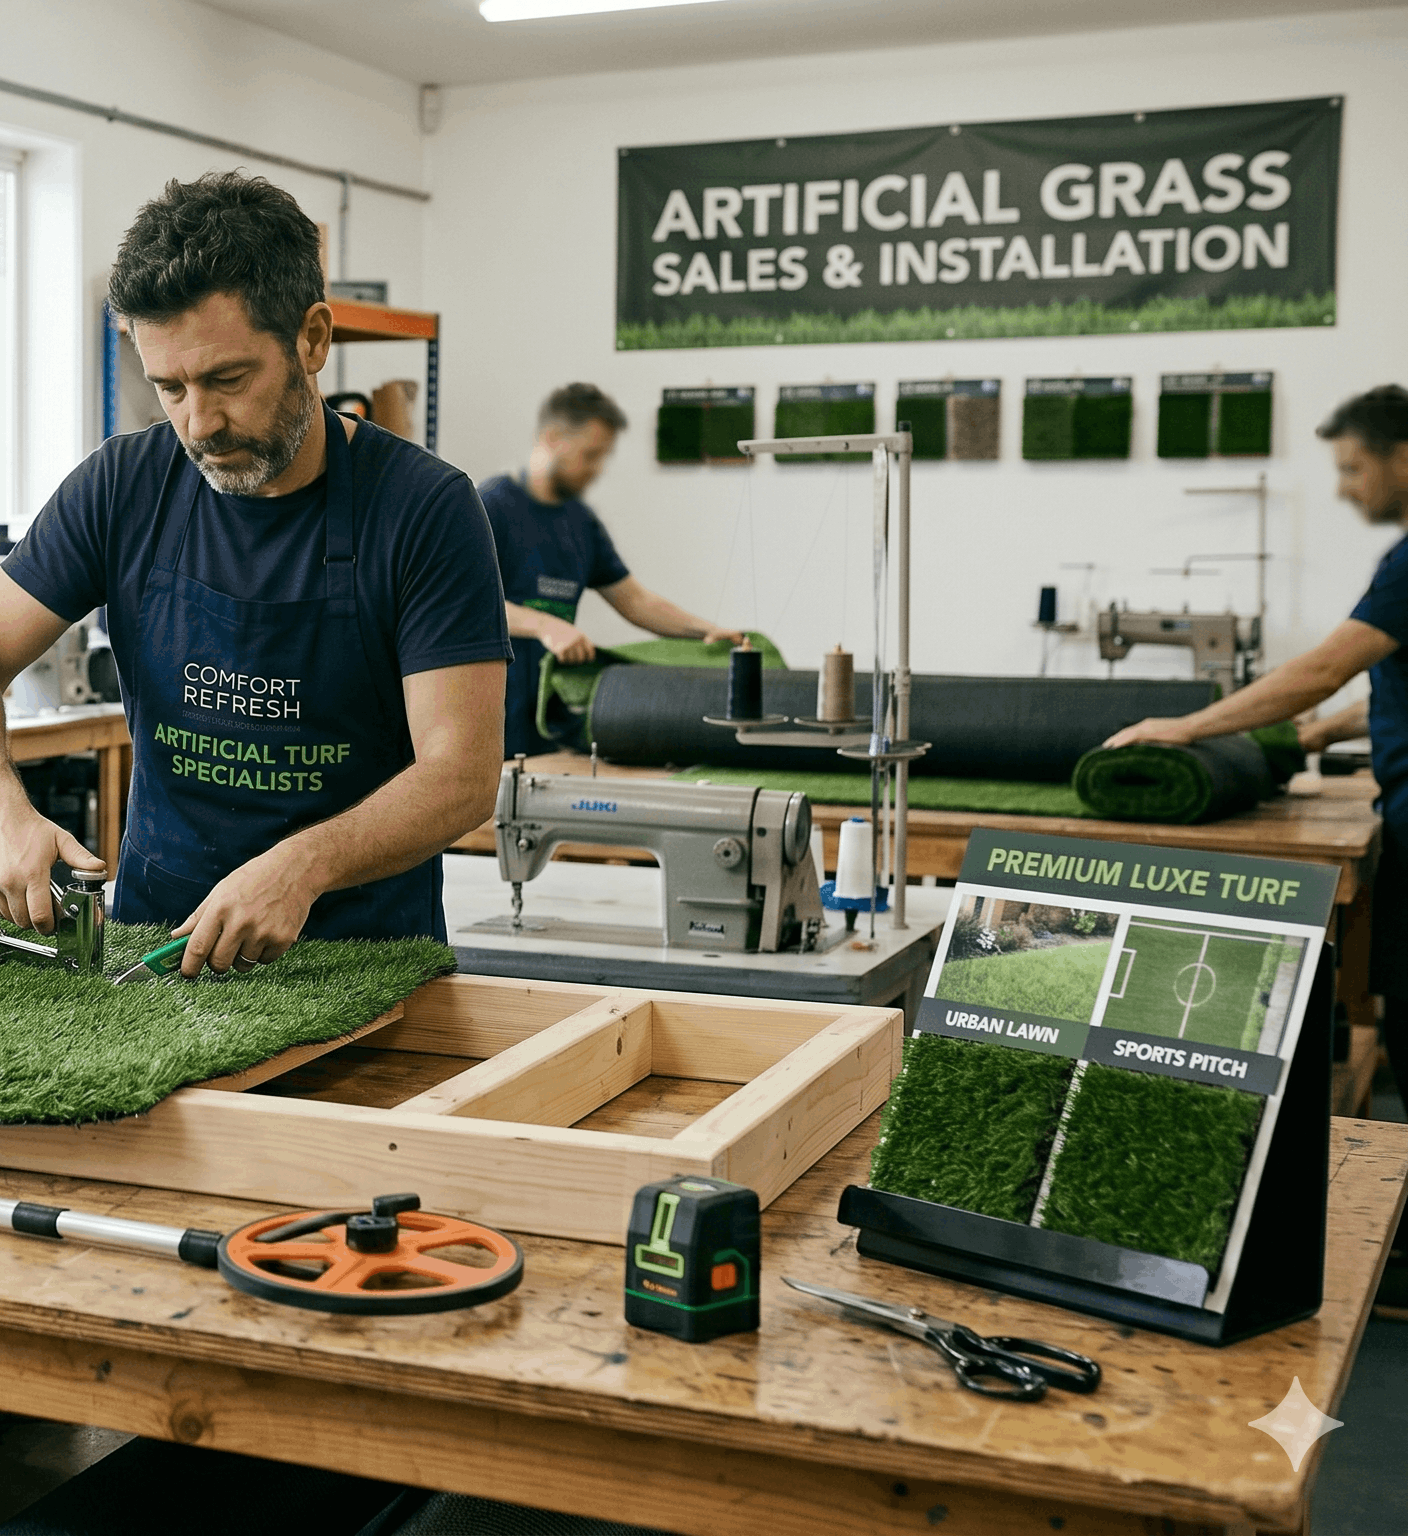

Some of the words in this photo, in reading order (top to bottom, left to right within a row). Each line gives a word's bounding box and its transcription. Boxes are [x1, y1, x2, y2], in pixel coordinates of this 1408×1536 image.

[652, 169, 1020, 243] ARTIFICIAL
[1039, 150, 1292, 222] GRASS
[652, 246, 808, 296] SALES
[822, 244, 863, 290] &
[878, 223, 1290, 286] INSTALLATION
[183, 662, 301, 697] COMFORT
[183, 685, 301, 720] REFRESH
[154, 722, 276, 765] ARTIFICIAL
[284, 743, 351, 766] TURF
[172, 755, 324, 792] SPECIALISTS
[987, 848, 1124, 887] PREMIUM
[1130, 863, 1210, 898] LUXE
[1219, 874, 1301, 907] TURF
[945, 1010, 1003, 1035] URBAN
[1005, 1020, 1060, 1045] LAWN
[1112, 1039, 1187, 1069] SPORTS
[1189, 1052, 1249, 1080] PITCH
